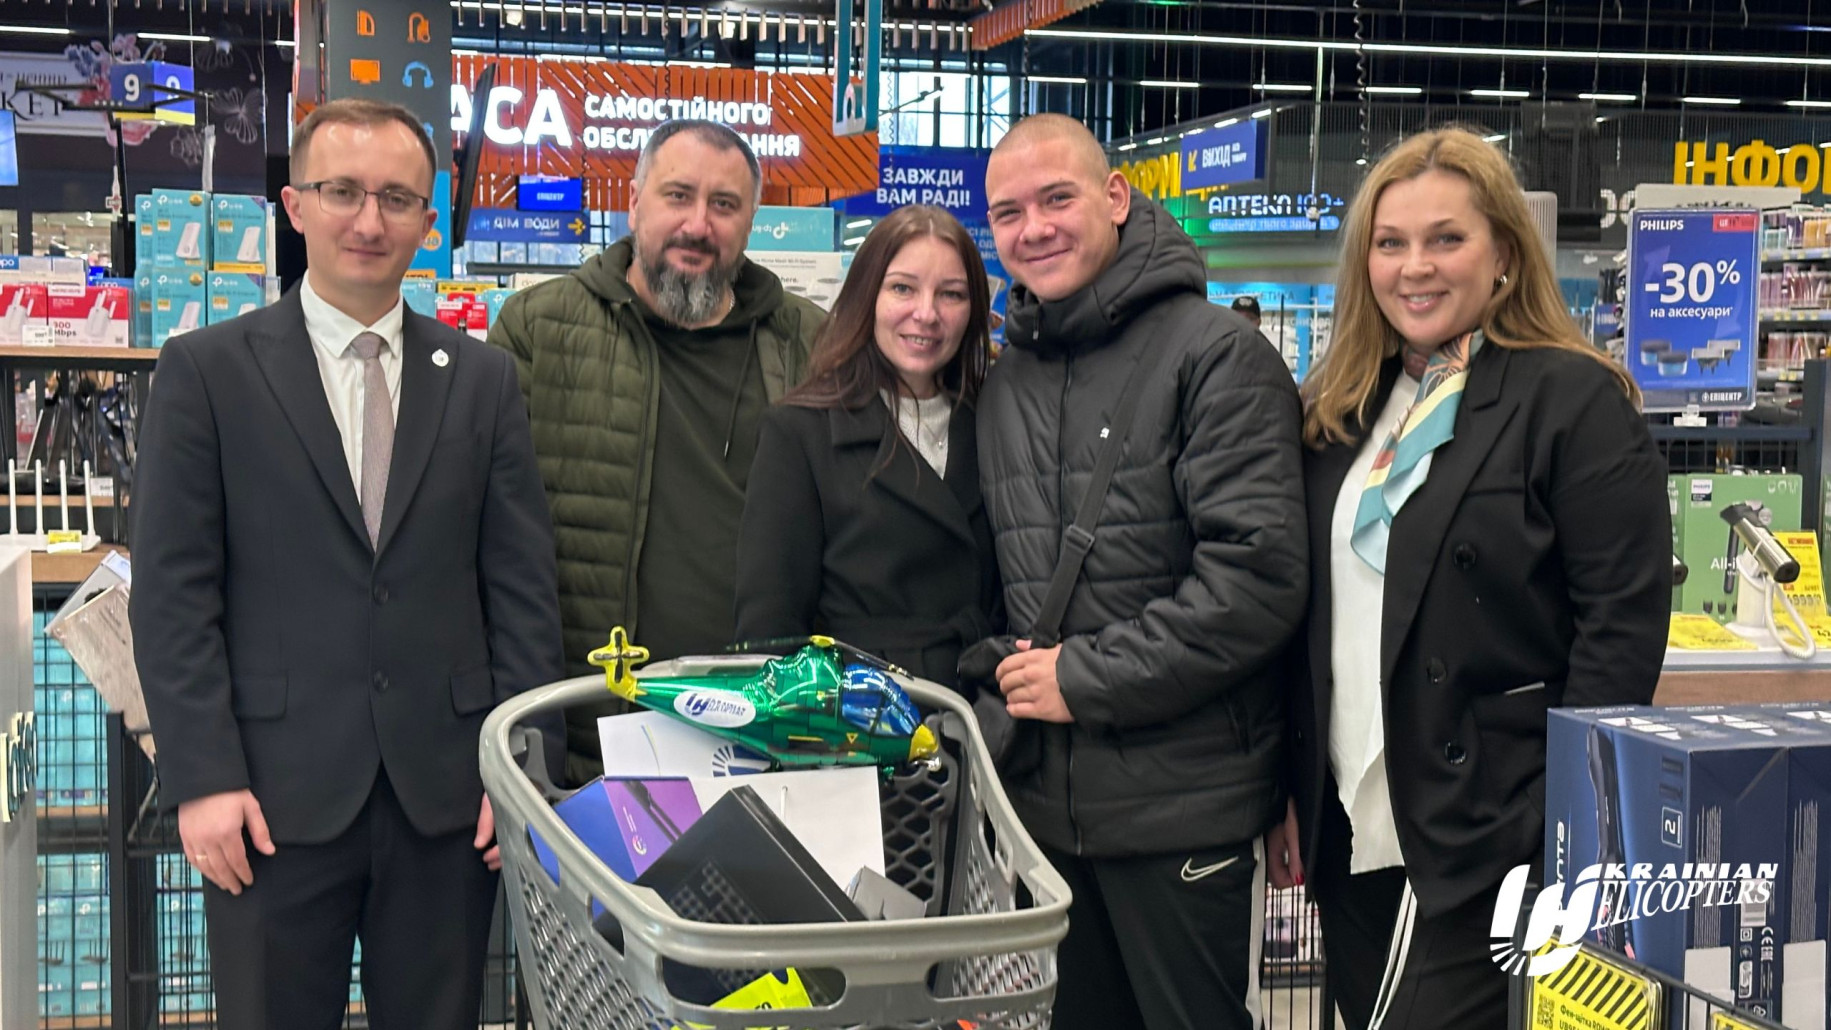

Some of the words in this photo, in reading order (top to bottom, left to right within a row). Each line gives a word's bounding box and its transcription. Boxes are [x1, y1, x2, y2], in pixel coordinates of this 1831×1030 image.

[124, 74, 140, 101] 9
[584, 95, 769, 126] САМОСТІЙНОГО
[1202, 144, 1231, 168] ВИХІД
[883, 167, 963, 187] ЗАВЖДИ
[876, 188, 916, 204] ВАМ
[922, 189, 970, 208] РАДІ!
[524, 217, 560, 231] ВОДИ
[1640, 219, 1684, 231] PHILIPS
[1645, 259, 1741, 304] -30%
[1650, 308, 1665, 318] на
[1709, 392, 1742, 402] ЕПІЦЕНТР
